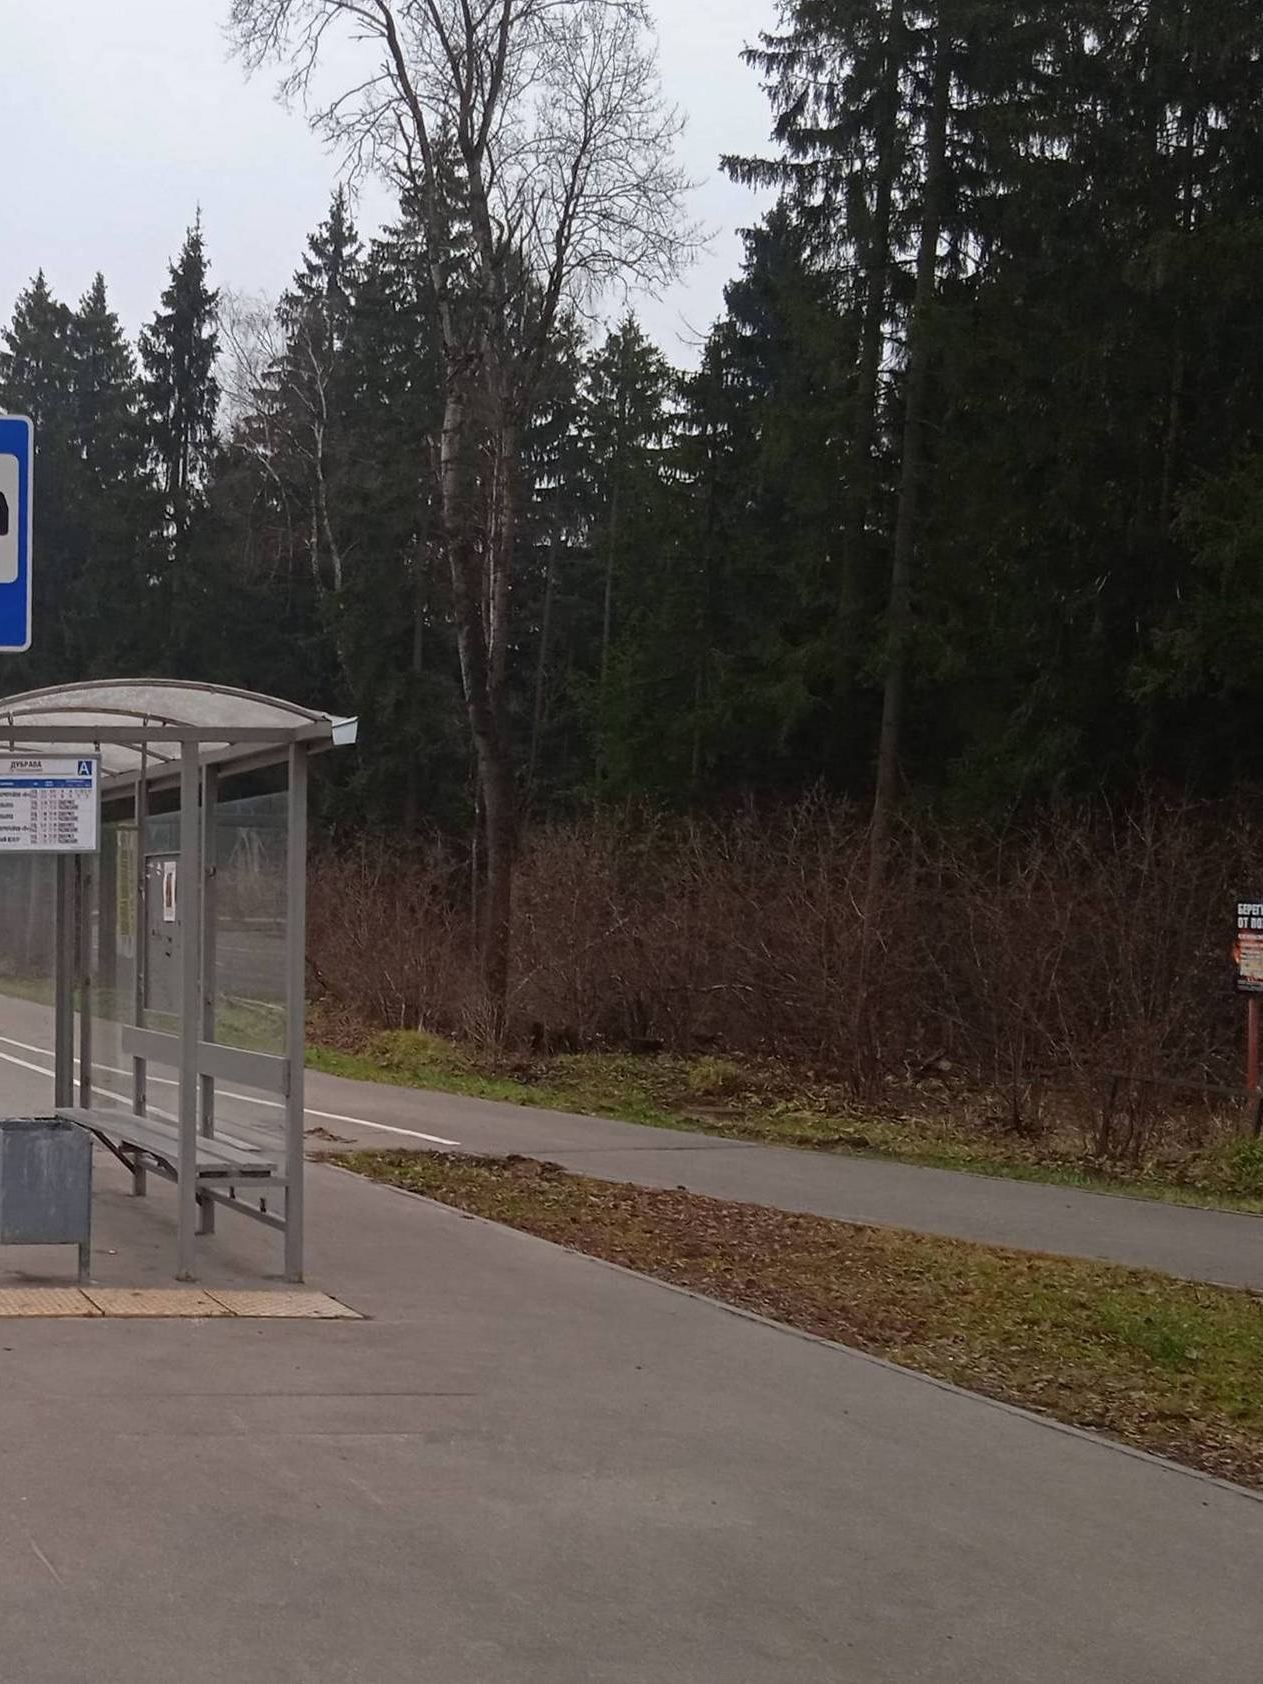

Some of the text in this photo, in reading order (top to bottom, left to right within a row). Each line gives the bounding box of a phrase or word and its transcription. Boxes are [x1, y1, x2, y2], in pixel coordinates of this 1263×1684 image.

[10, 761, 42, 769] ДУБРАВА
[1238, 918, 1263, 930] ОТ ПО
